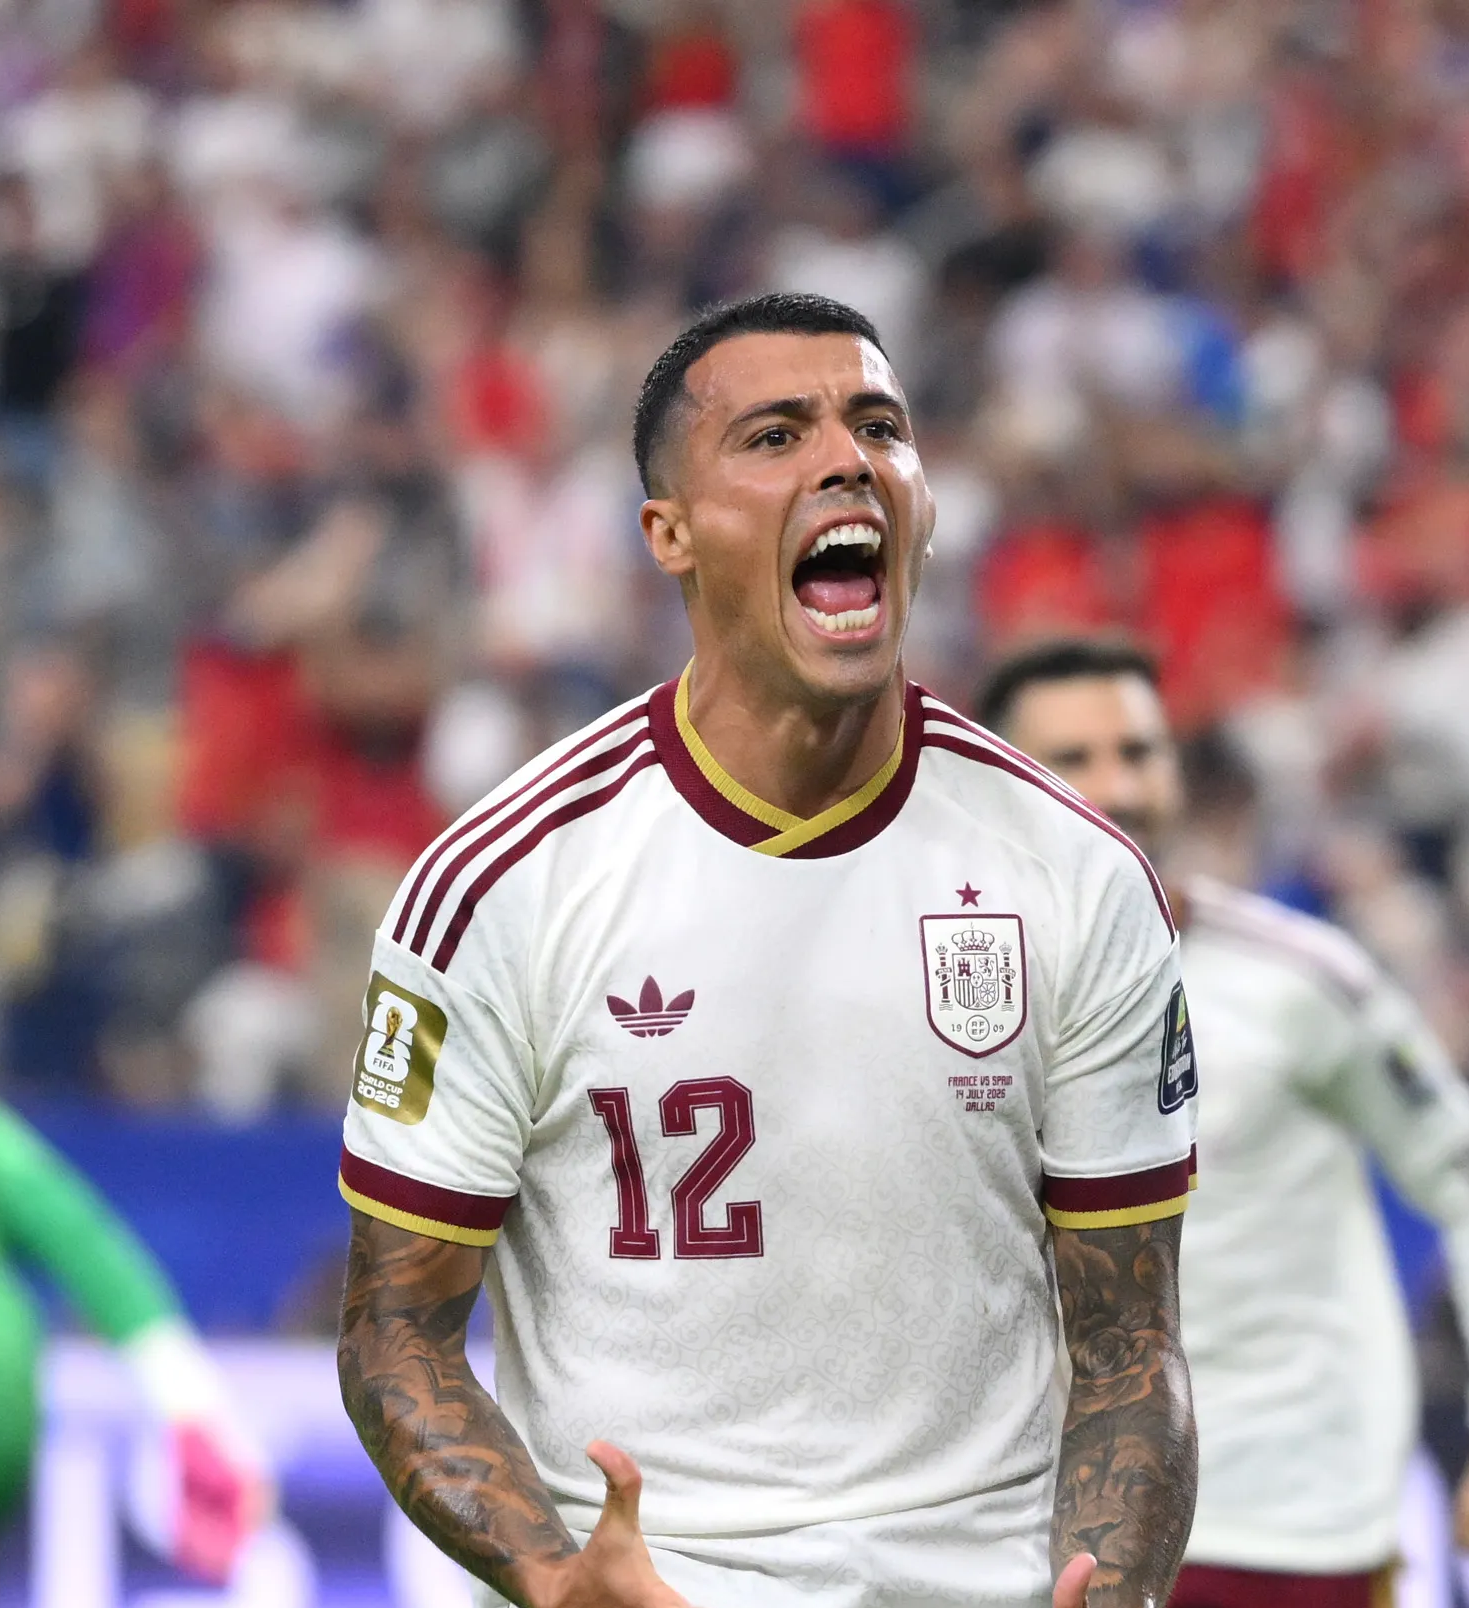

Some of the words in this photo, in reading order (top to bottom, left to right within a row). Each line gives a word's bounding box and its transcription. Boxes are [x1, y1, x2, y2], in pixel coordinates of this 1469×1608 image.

[373, 1057, 395, 1073] FIFA
[948, 1076, 978, 1087] FRANCE
[980, 1076, 990, 1086] VS
[992, 1075, 1013, 1086] SPAIN
[357, 1081, 401, 1109] 2026
[385, 1082, 403, 1095] CUP
[956, 1089, 964, 1099] 14
[966, 1089, 985, 1099] JULY
[987, 1089, 1006, 1099] 2026
[965, 1102, 995, 1112] DALLAS
[587, 1075, 764, 1260] 12
